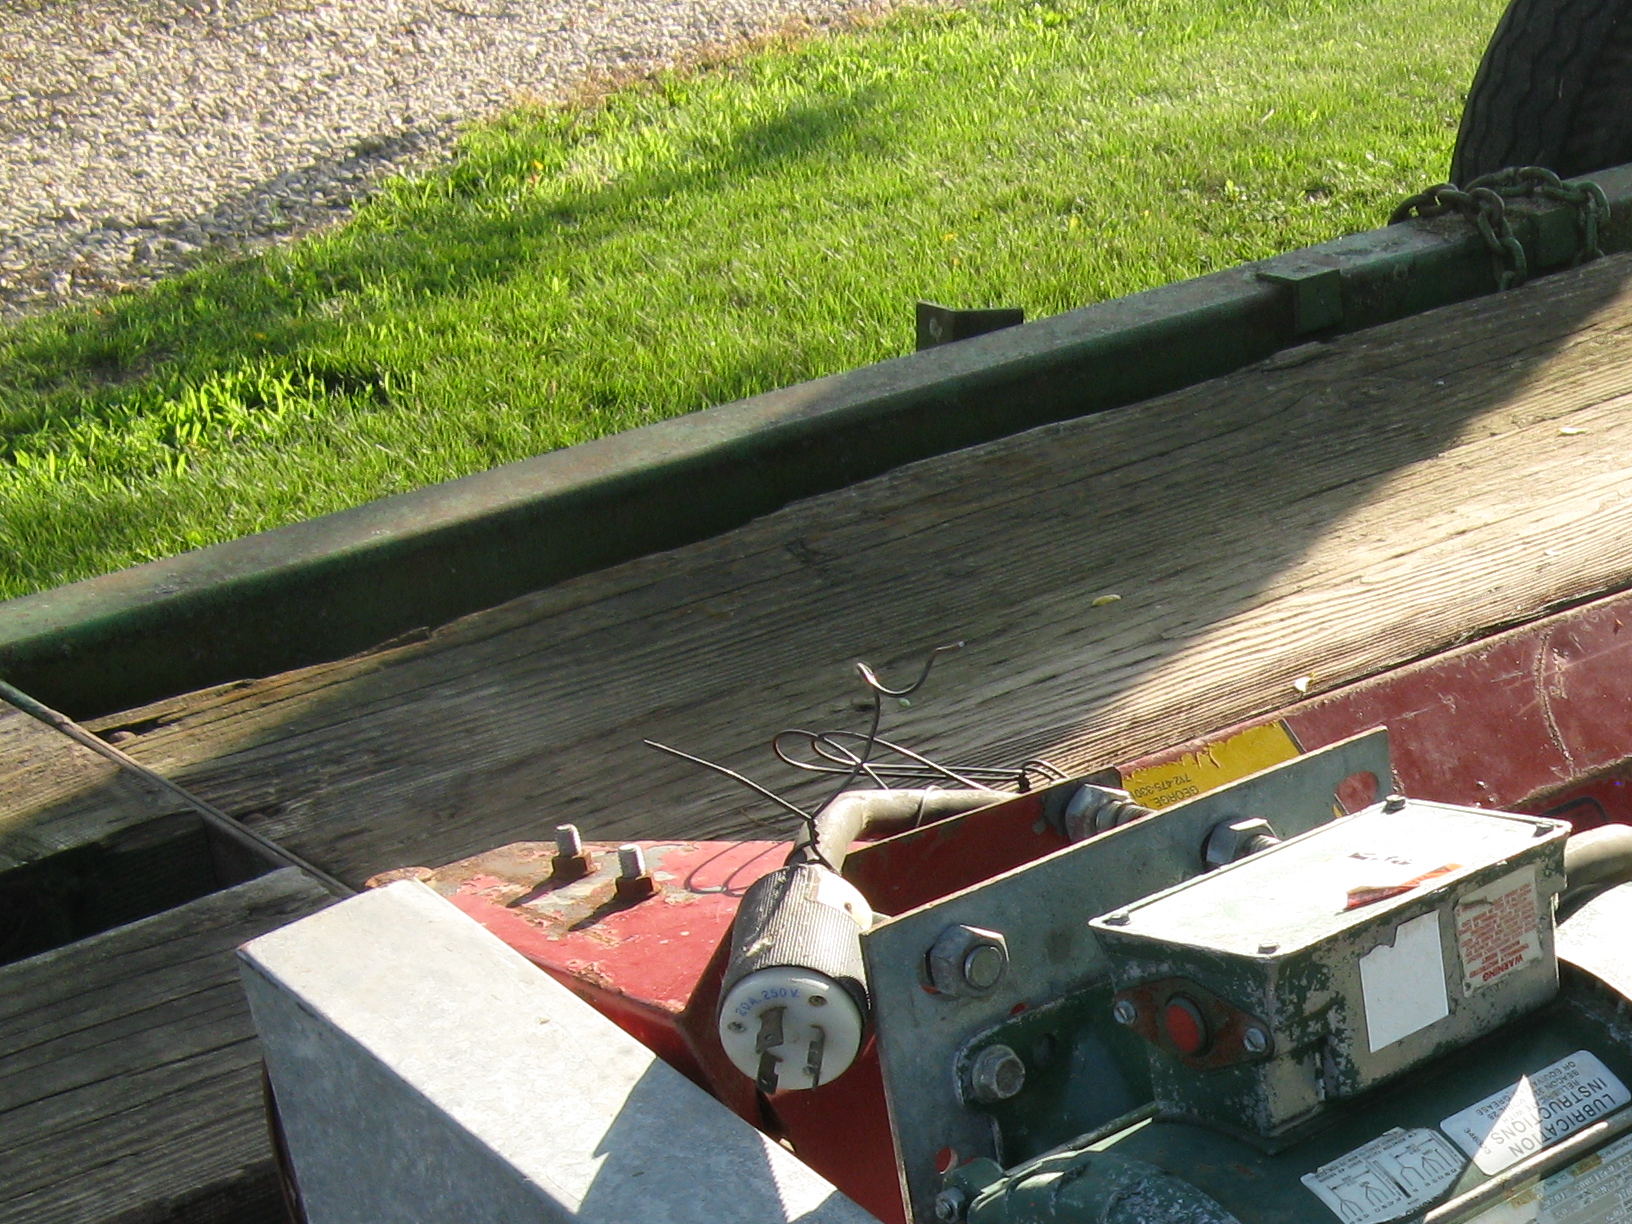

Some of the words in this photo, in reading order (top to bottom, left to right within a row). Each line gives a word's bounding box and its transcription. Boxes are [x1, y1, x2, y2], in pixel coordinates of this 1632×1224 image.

[1482, 954, 1524, 982] WARNING
[761, 987, 787, 999] 250
[1560, 1059, 1577, 1071] OR
[1474, 1093, 1513, 1117] GREASE
[1489, 1077, 1608, 1146] INSTRUCTIONS
[1499, 1108, 1525, 1125] WITH
[1509, 1094, 1617, 1158] LUBRICATION
